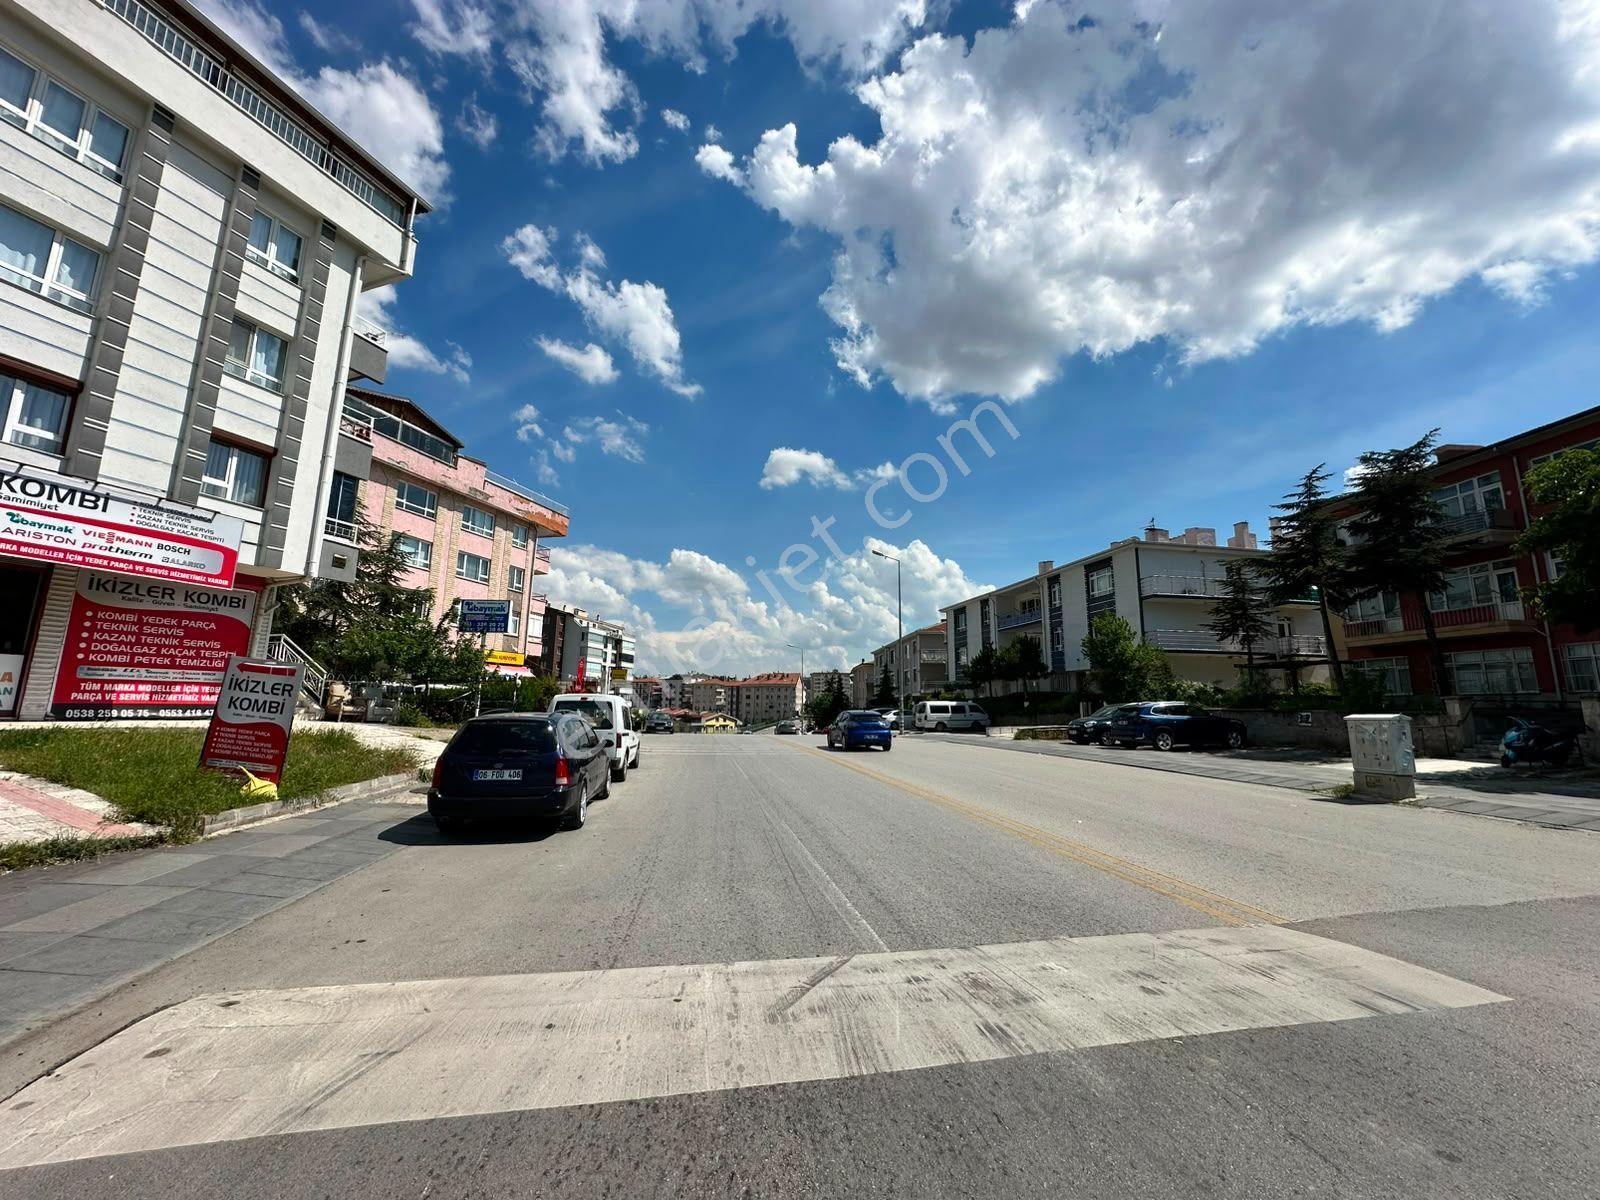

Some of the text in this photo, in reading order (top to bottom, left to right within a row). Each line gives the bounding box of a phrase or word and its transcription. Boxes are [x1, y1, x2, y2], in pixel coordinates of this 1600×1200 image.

[0, 473, 110, 512] KOMBİ
[20, 517, 74, 534] baymak
[156, 542, 191, 555] BOSCH
[1, 527, 206, 570] ARISTON protherm ALARKO
[19, 546, 65, 559] MODELLER
[65, 551, 84, 563] İÇİN
[85, 556, 109, 566] YEDEK
[110, 561, 134, 572] PARÇA
[145, 566, 169, 576] SERVİS
[87, 574, 248, 610] İKİZLER KOMBİ
[95, 621, 185, 636] TEKNİK SERVİS
[97, 610, 217, 630] KOMBİ YEDEK PARÇA
[91, 641, 157, 654] DOĞALGAZ
[161, 647, 197, 658] KAÇAK
[93, 632, 221, 649] KAZAN TEKNİK SERVİS
[88, 652, 225, 668] KOMBİ PETEK TEMİZLİĞİ
[0, 687, 13, 695] N
[80, 681, 221, 694] TÜM MARKA MODELLER İÇİN YEDE
[227, 673, 295, 697] İKİZLER
[70, 692, 102, 702] PARÇA
[105, 692, 117, 701] VE
[118, 692, 151, 701] SERVİS
[227, 695, 286, 715] KOMBİ
[65, 709, 95, 718] 0538
[97, 709, 118, 718] 259
[119, 709, 134, 717] 05
[136, 709, 150, 717] 75
[159, 709, 182, 717] 0553
